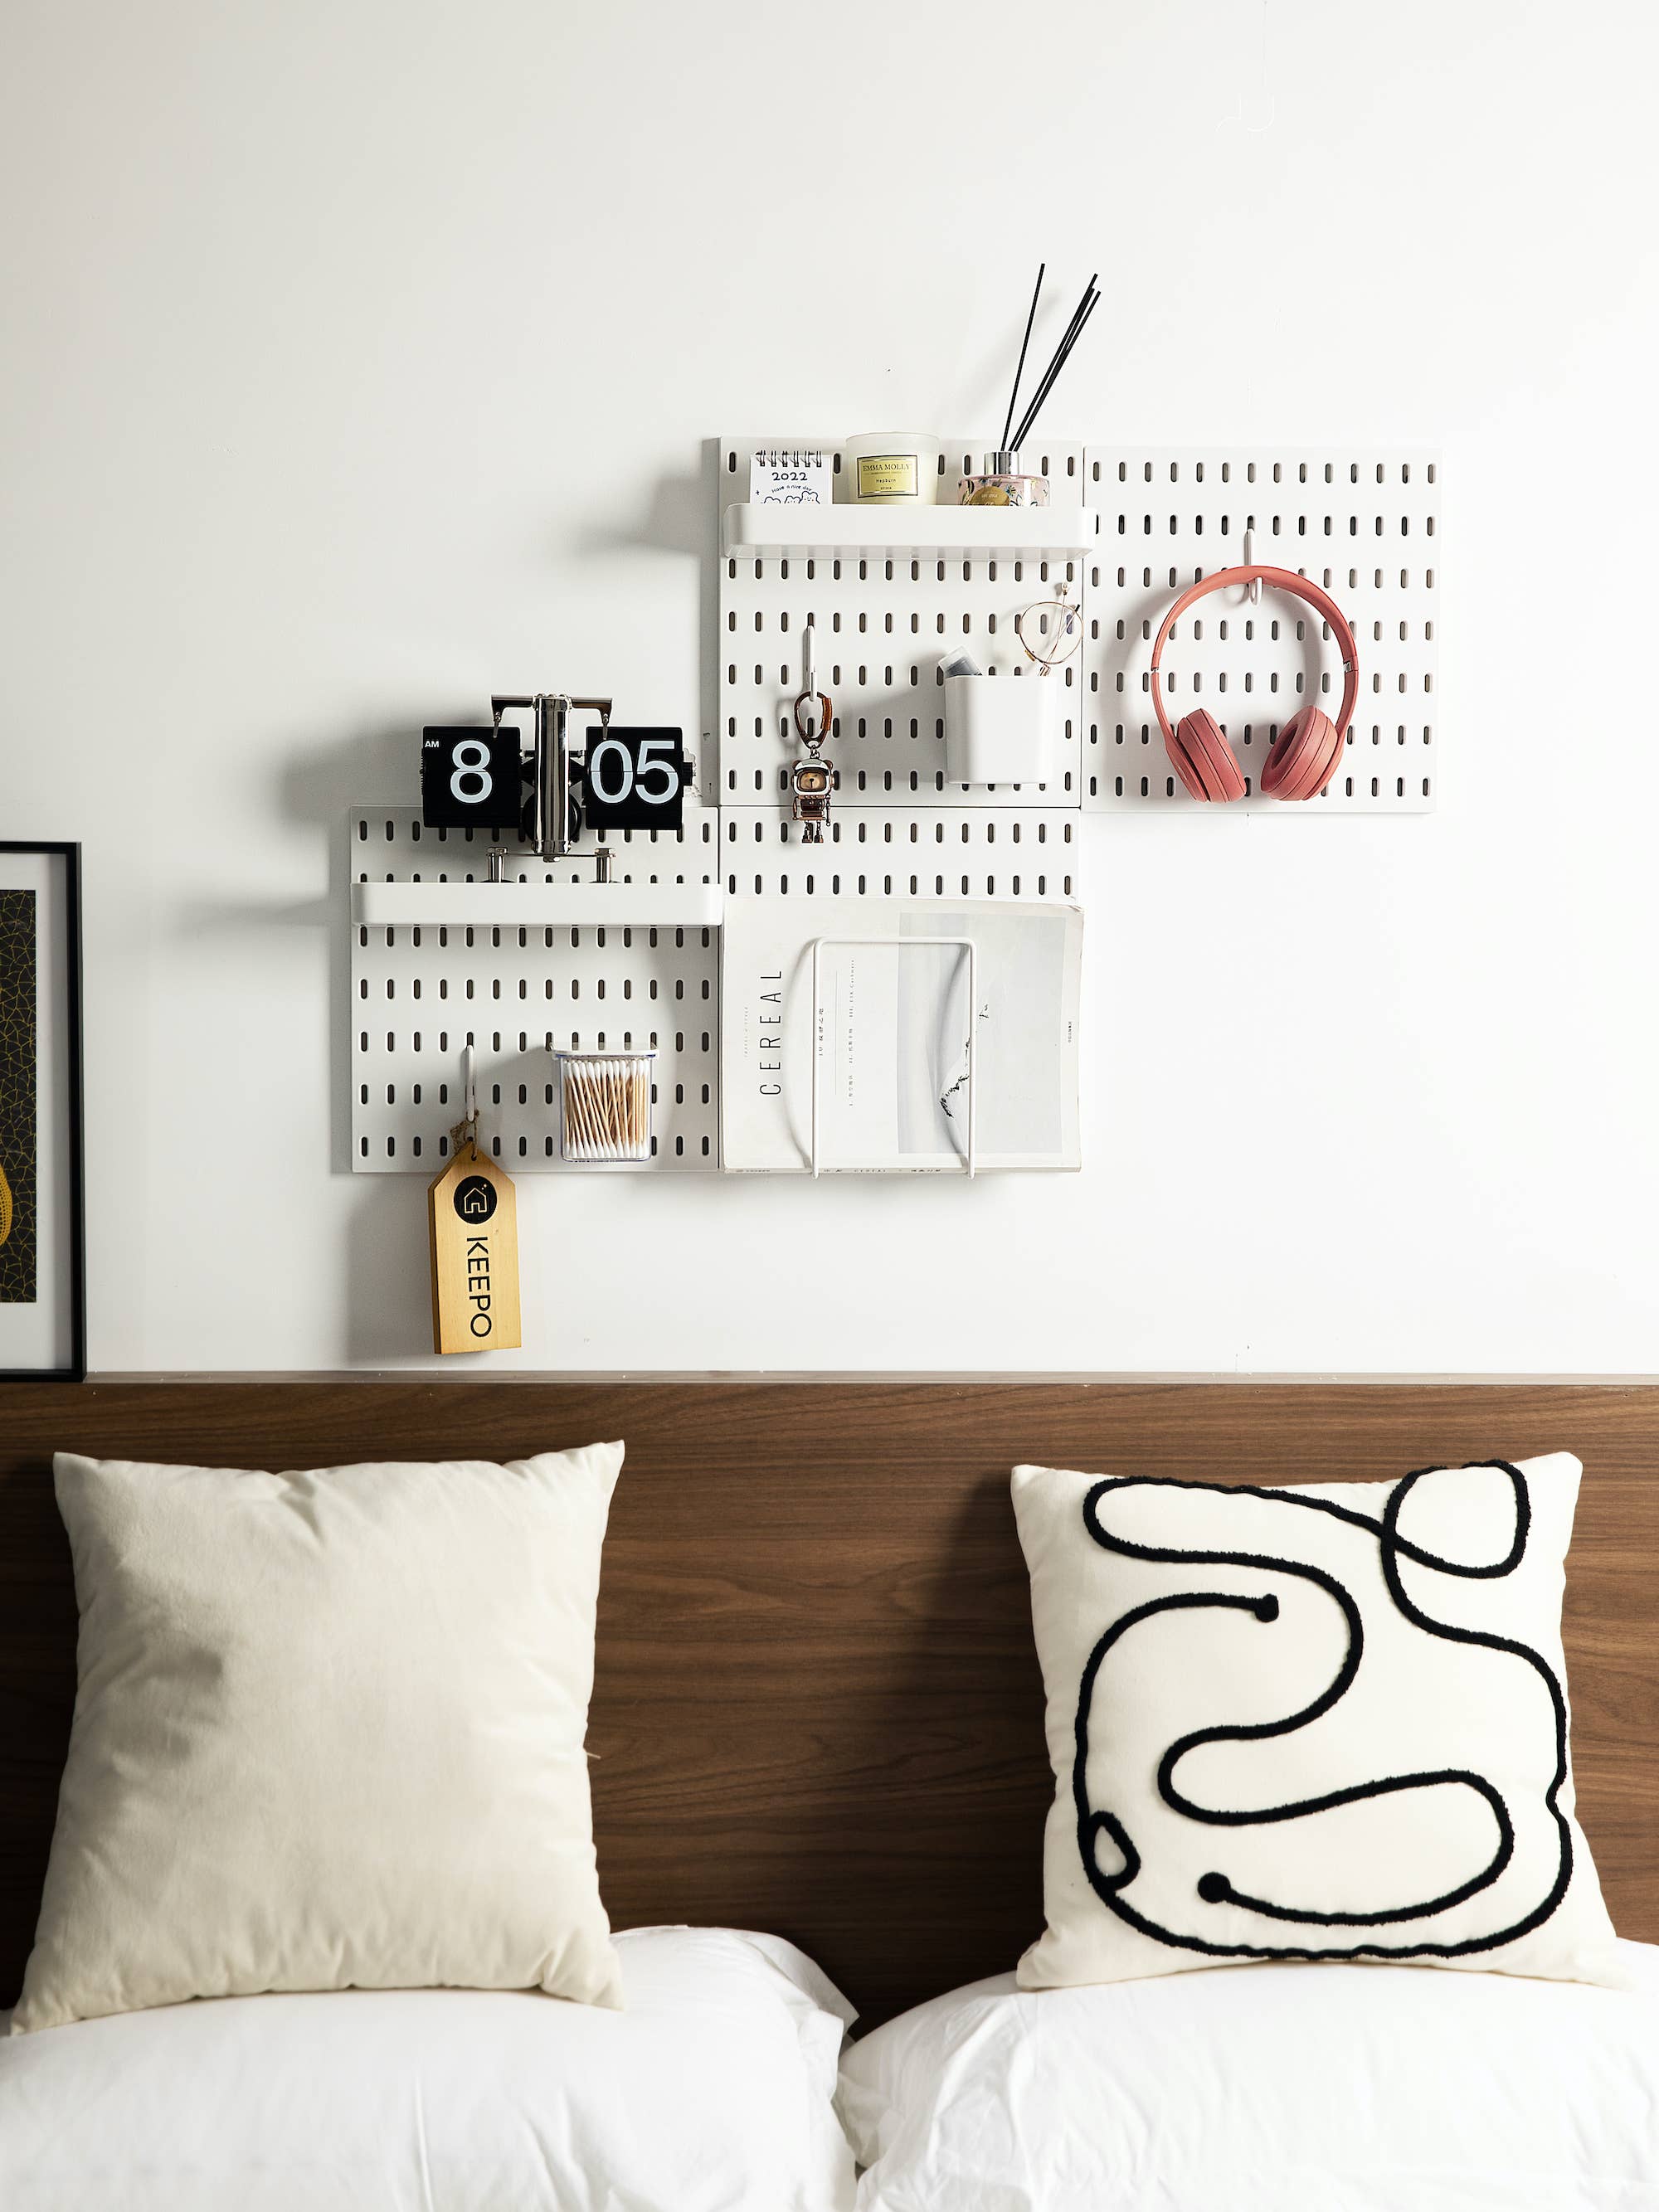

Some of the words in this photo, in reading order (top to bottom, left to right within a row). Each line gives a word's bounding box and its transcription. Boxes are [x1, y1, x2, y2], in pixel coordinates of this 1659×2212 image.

[771, 472, 808, 481] 2022
[450, 740, 493, 804] 8
[591, 740, 679, 804] 05
[759, 971, 781, 1096] CEREAL
[466, 1237, 492, 1337] KEEPO
